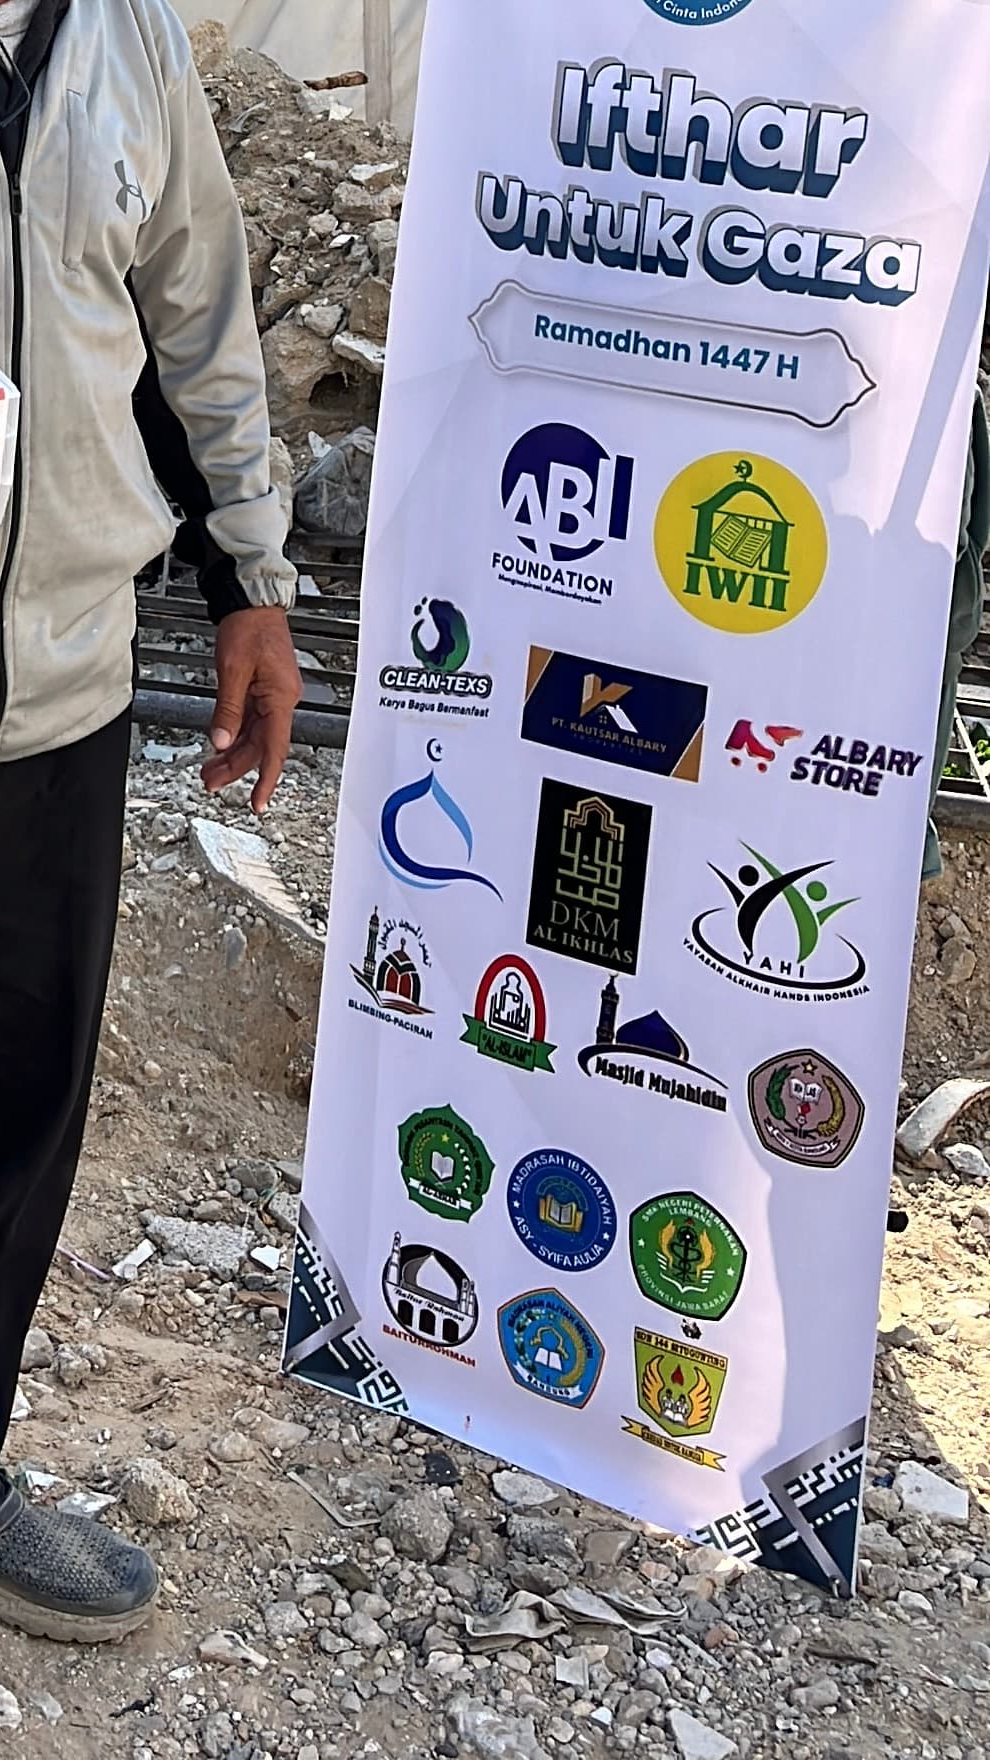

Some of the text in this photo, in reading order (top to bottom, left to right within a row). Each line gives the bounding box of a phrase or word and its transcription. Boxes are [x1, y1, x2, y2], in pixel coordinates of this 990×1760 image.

[663, 0, 697, 19] Cinta
[551, 57, 868, 198] Ifthar
[475, 172, 922, 306] Untuk Gaza
[534, 314, 800, 379] Ramadhan 1447 H
[502, 454, 634, 556] ABI
[492, 552, 613, 596] FOUNDATION
[683, 561, 790, 612] IWII
[382, 668, 491, 696] CLEAN-TEXS
[379, 697, 490, 717] Karya Bagus Bermanfaat
[790, 756, 883, 796] STORE
[811, 735, 924, 777] ALBARY
[550, 900, 620, 942] DKM
[534, 924, 634, 964] AL IKHLAS
[743, 951, 805, 978] YAHI
[726, 972, 770, 995] ALKHAIR
[813, 985, 870, 1002] INDONESIA
[595, 1056, 727, 1112] Masjid Mujahidin
[512, 1154, 564, 1194] MADRASAH
[567, 1159, 612, 1225] IBTIDAIYAH
[538, 1245, 572, 1267] SYIFA
[573, 1243, 605, 1267] AULIA
